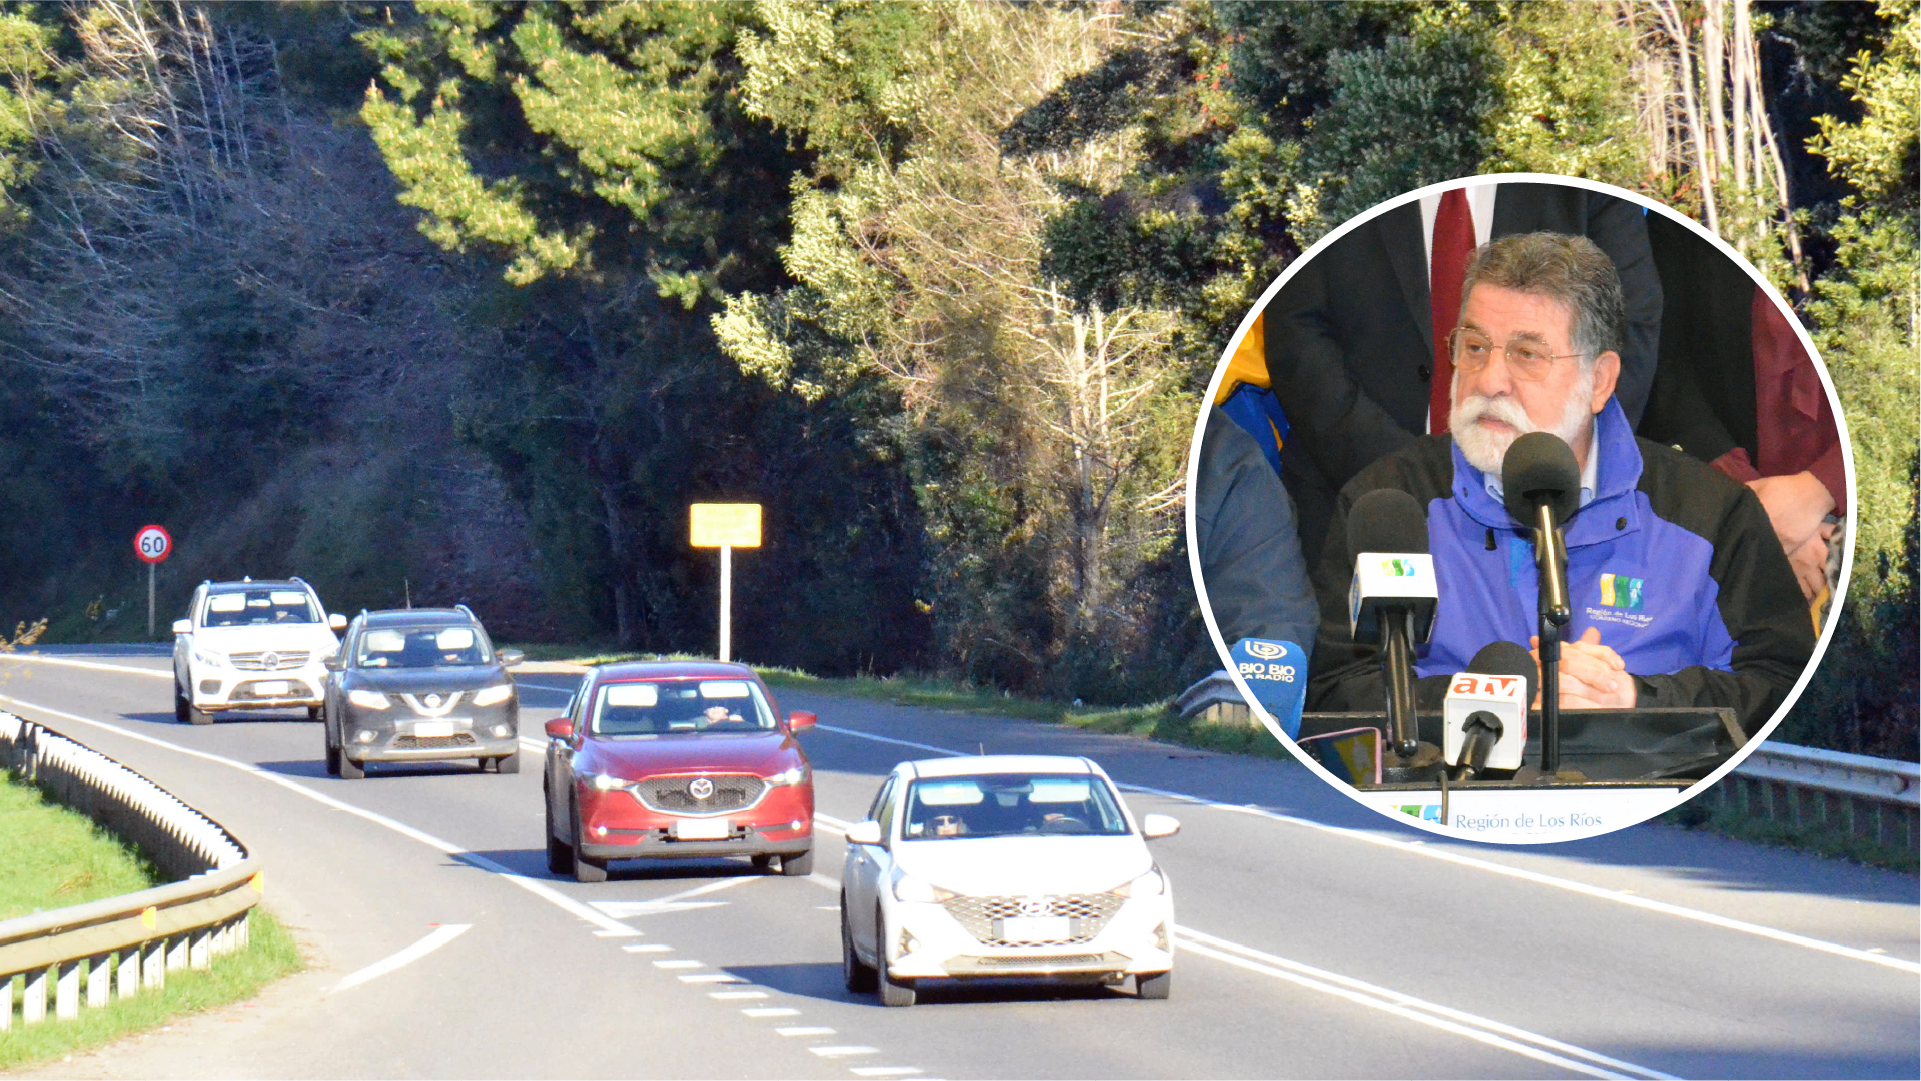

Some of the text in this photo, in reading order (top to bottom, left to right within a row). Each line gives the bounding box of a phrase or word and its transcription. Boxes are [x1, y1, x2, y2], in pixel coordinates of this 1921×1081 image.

[141, 536, 164, 553] 60
[1239, 662, 1296, 676] BIO BIO
[1255, 673, 1294, 683] RADIO
[1456, 812, 1603, 831] Región de Los Ríos
